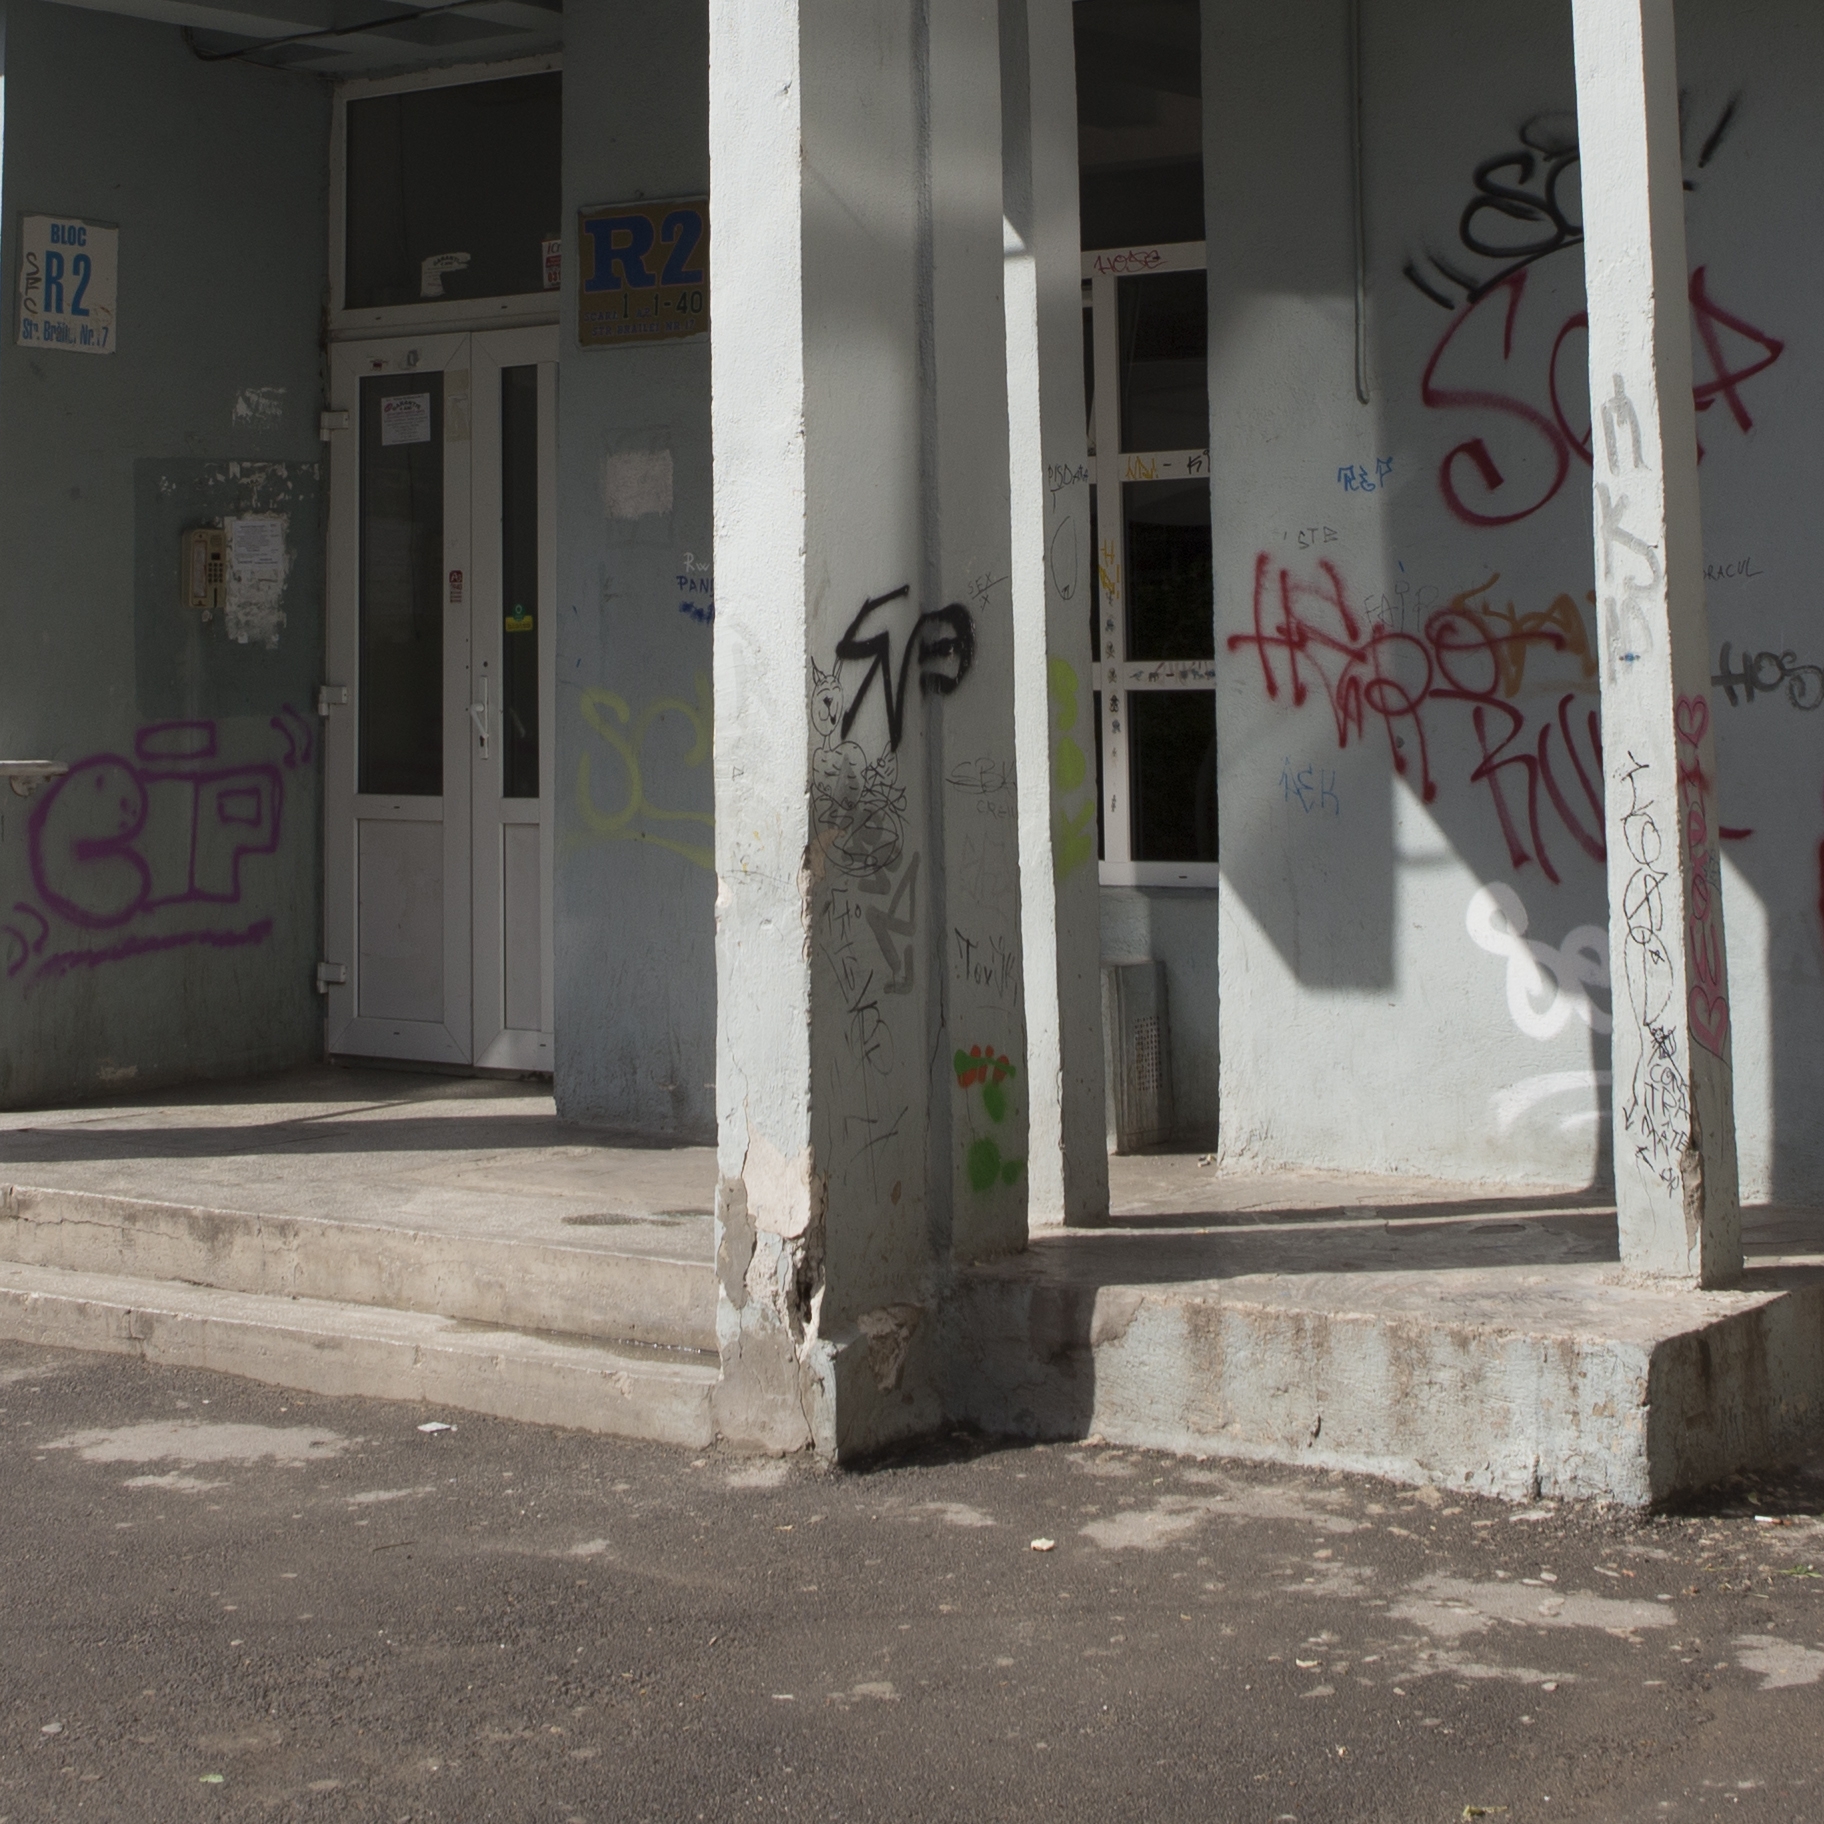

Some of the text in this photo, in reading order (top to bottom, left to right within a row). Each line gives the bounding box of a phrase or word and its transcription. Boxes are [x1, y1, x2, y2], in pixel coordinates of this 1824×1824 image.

[50, 223, 87, 247] BLOC
[582, 208, 705, 294] R2
[622, 292, 629, 319] 1
[653, 290, 704, 316] 1-40
